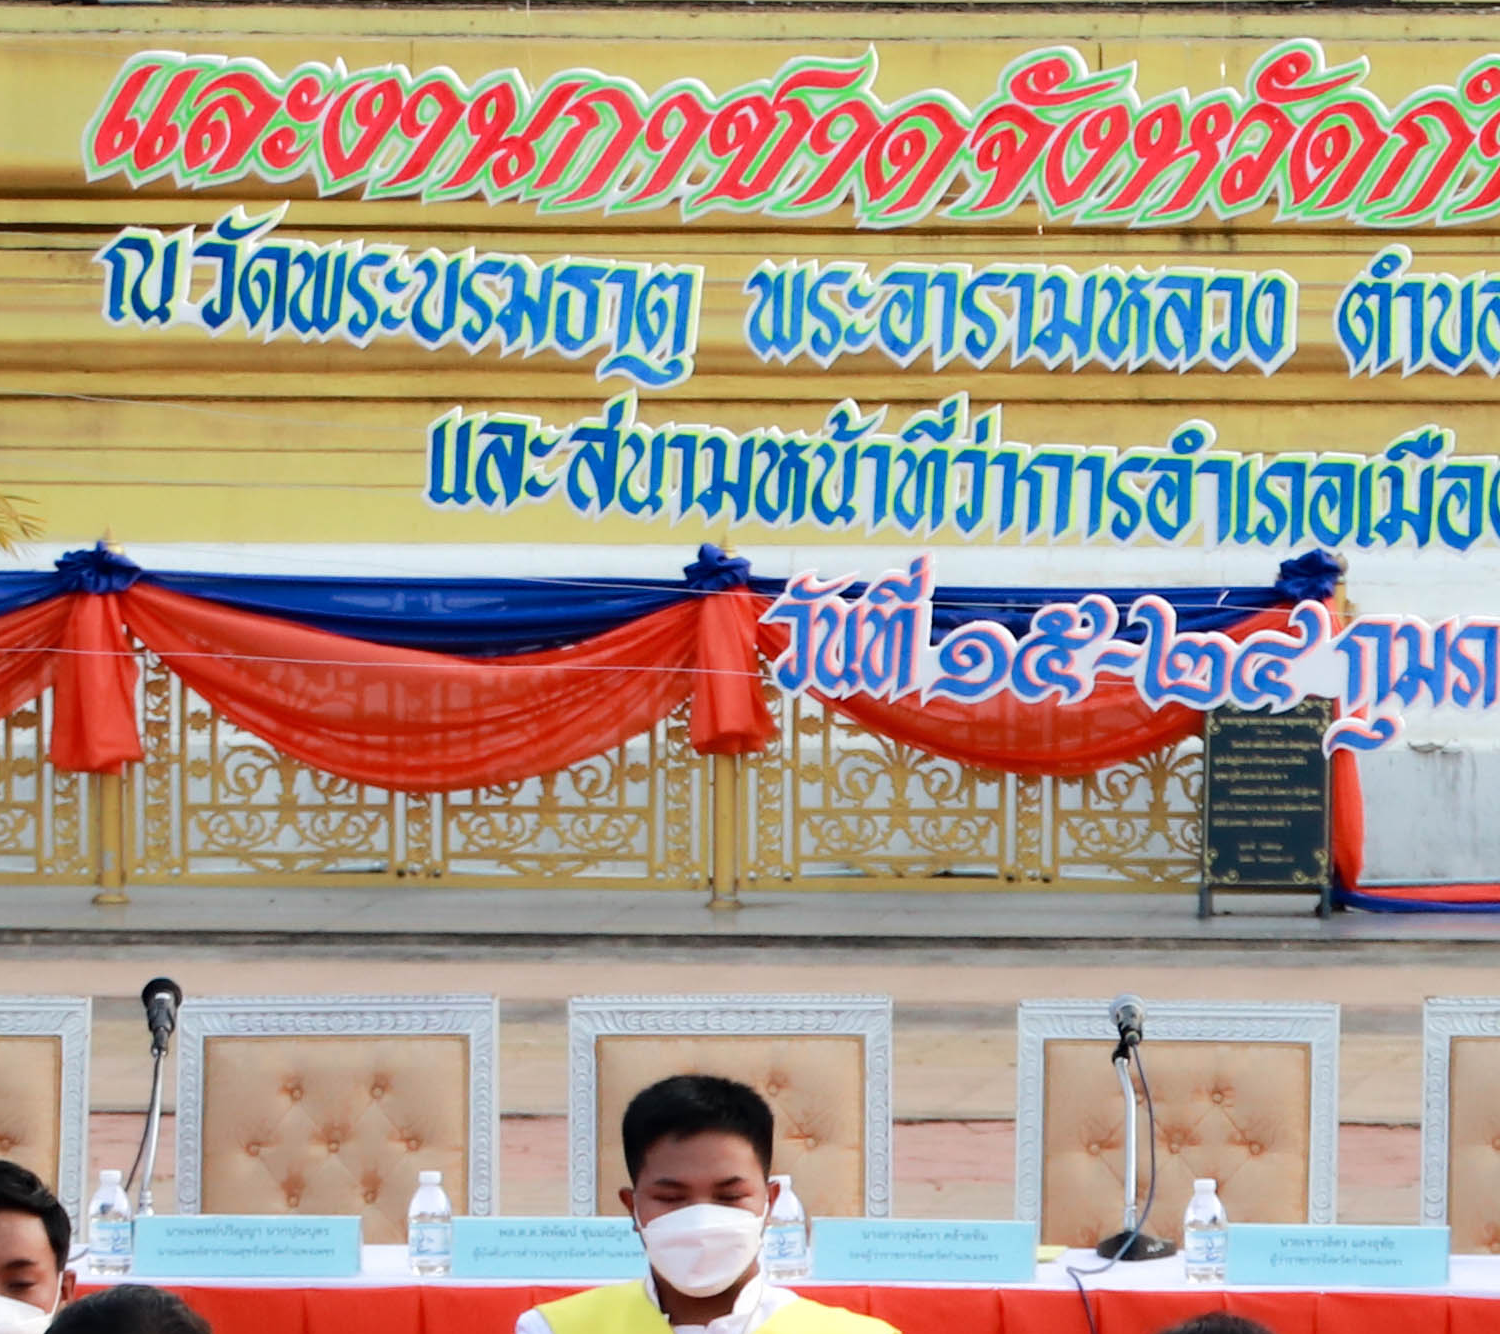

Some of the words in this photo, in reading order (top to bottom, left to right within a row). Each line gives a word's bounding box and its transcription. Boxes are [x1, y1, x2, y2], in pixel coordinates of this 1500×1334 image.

[747, 262, 1296, 371] พระอารามหลวง
